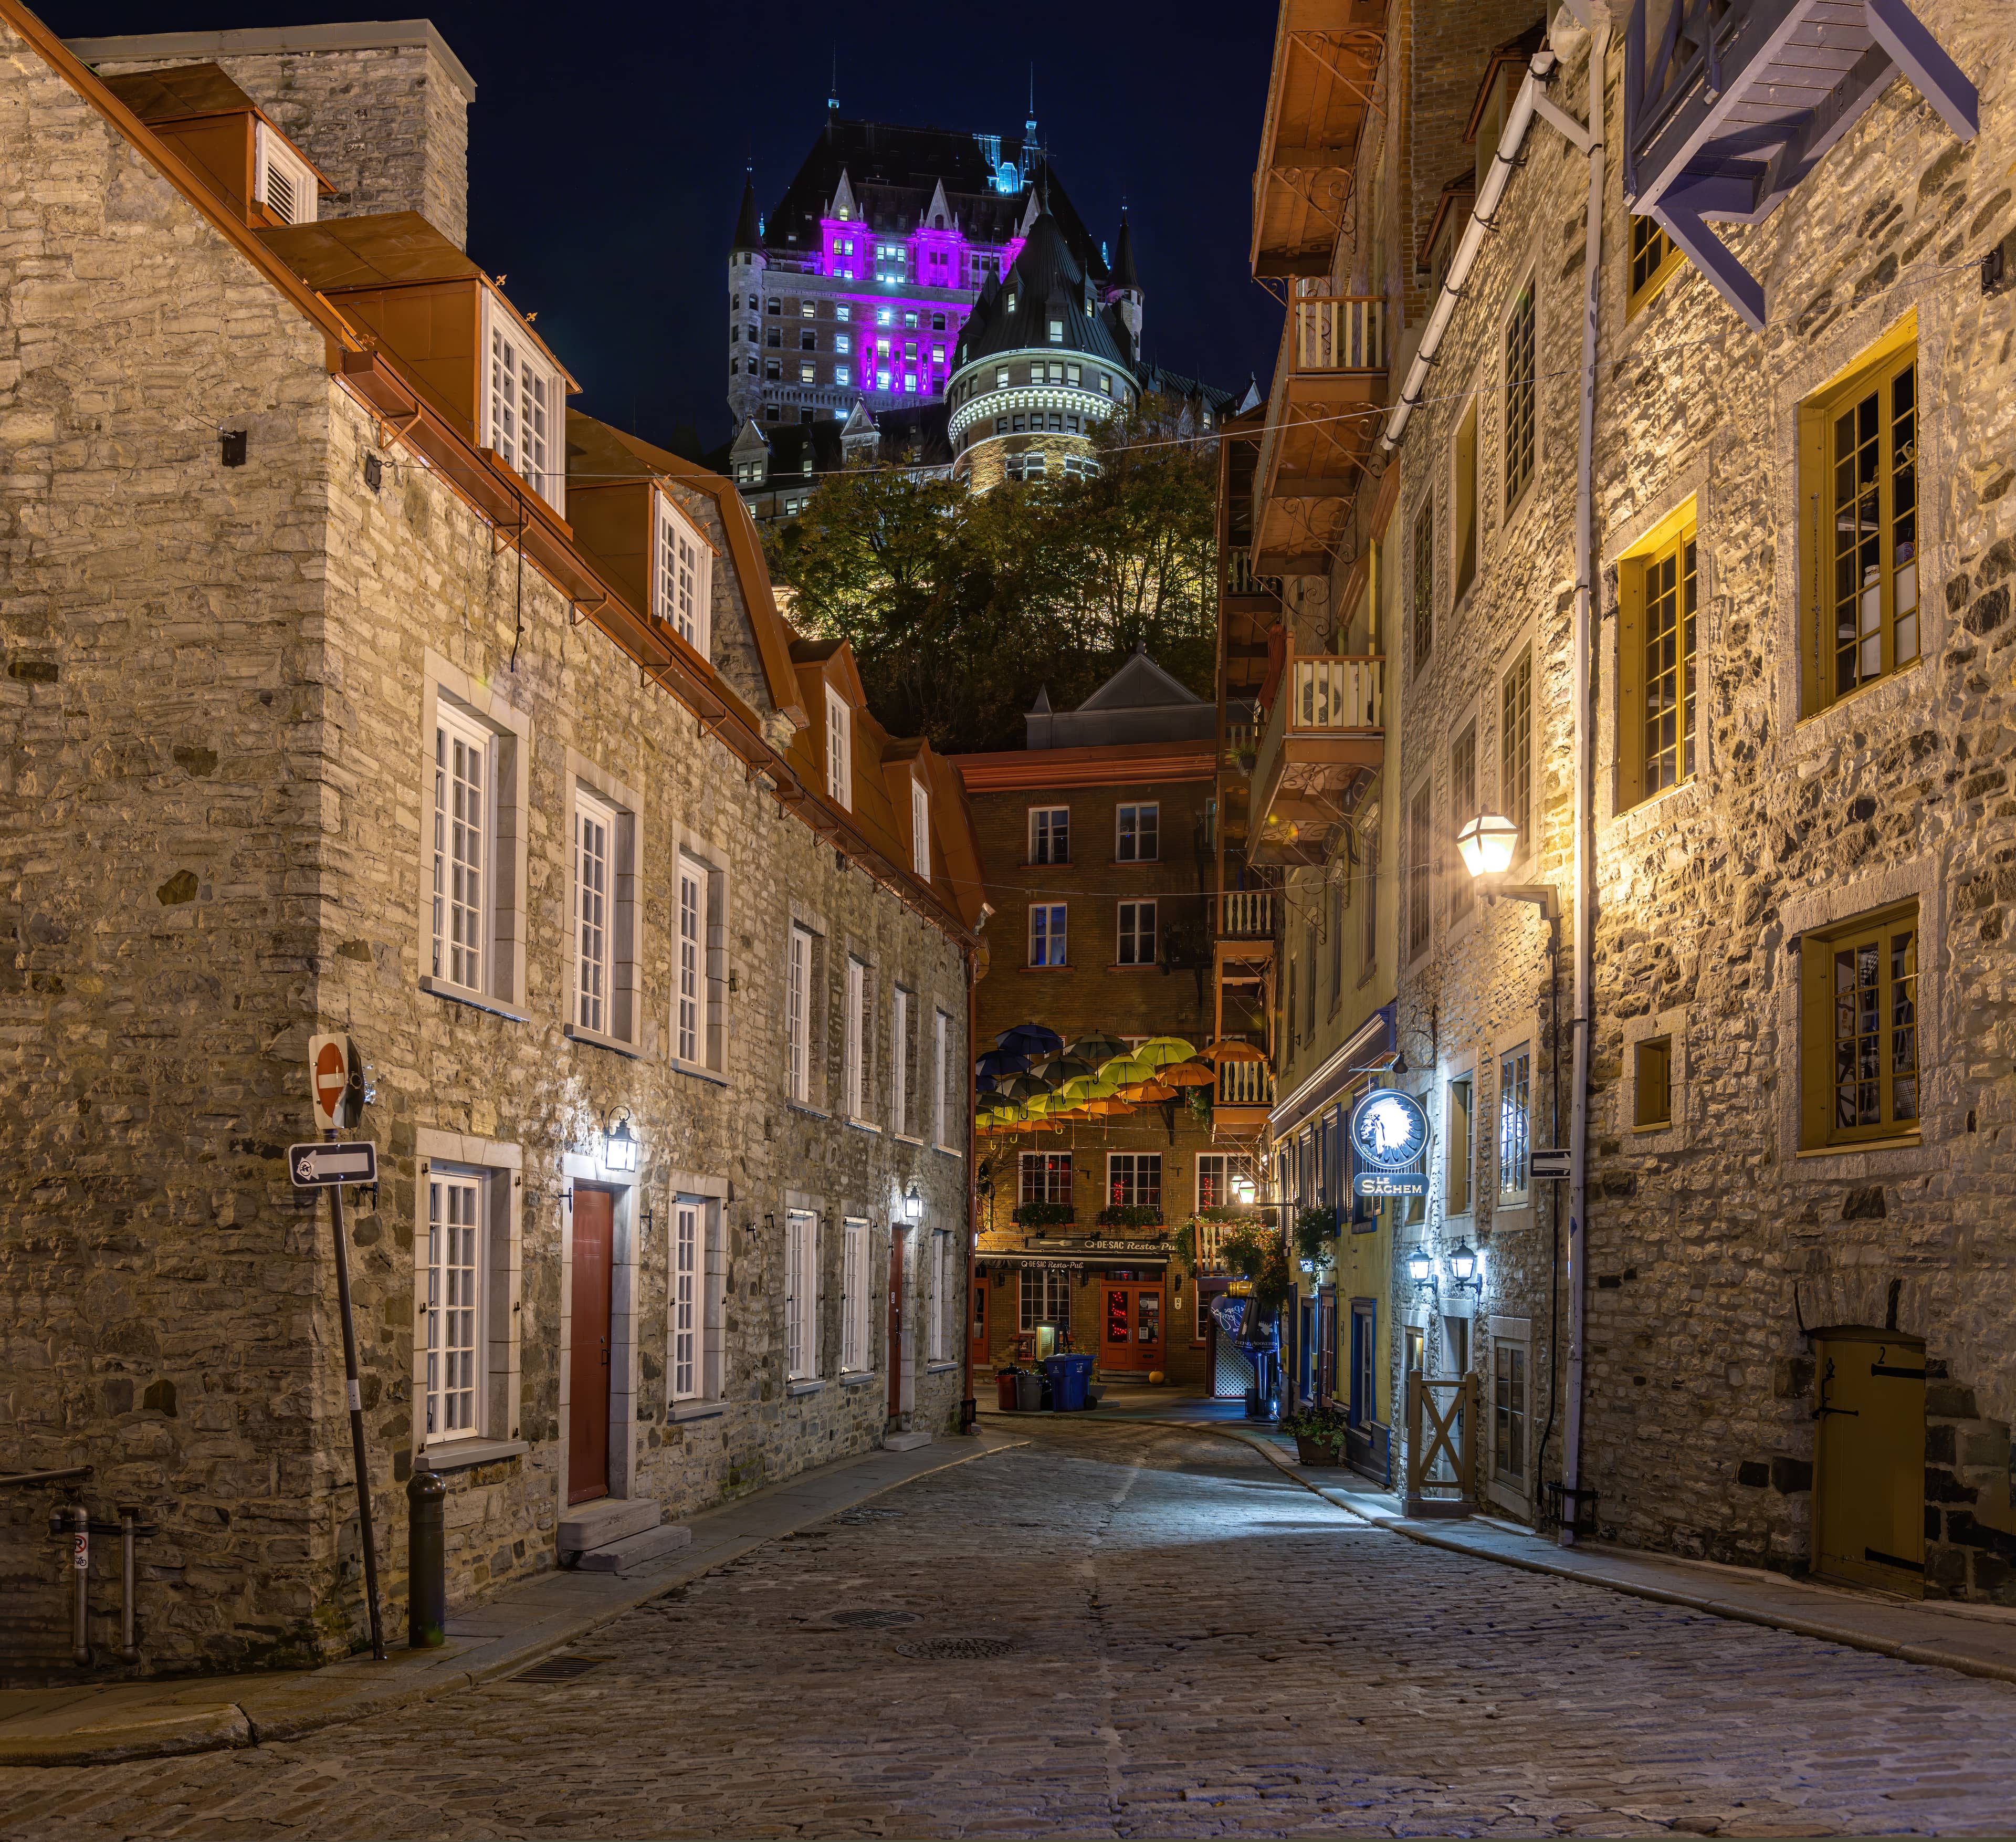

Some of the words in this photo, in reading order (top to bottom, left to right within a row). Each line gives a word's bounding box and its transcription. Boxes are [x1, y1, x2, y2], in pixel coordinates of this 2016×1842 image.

[1361, 1145, 1372, 1157] DEPUIS
[1362, 1179, 1422, 1194] SACHEM
[1127, 1241, 1177, 1251] Resto-Pu
[1877, 1346, 1886, 1364] 2
